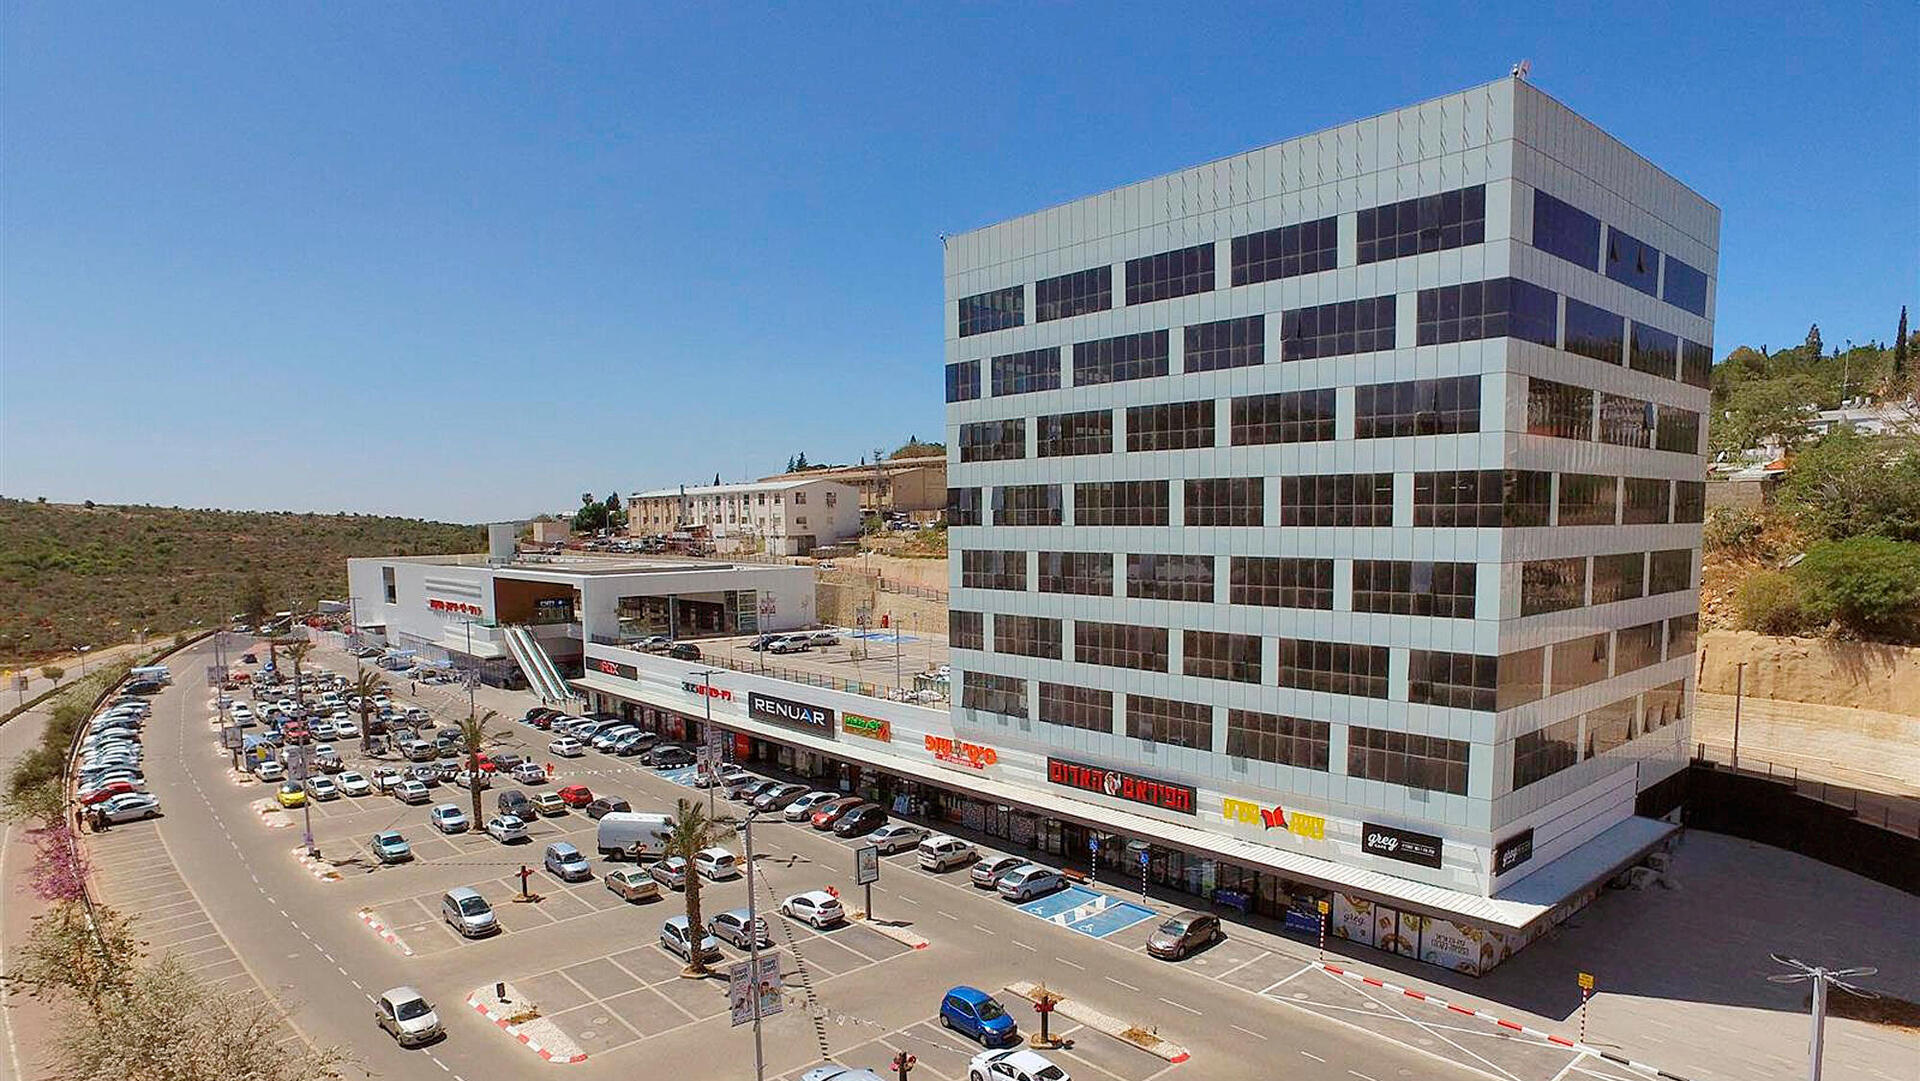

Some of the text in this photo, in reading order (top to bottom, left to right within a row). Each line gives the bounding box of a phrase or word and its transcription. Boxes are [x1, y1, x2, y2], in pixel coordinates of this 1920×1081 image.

[754, 698, 826, 726] RENUAR
[1050, 761, 1103, 792] האדום
[1367, 833, 1399, 852] greg
